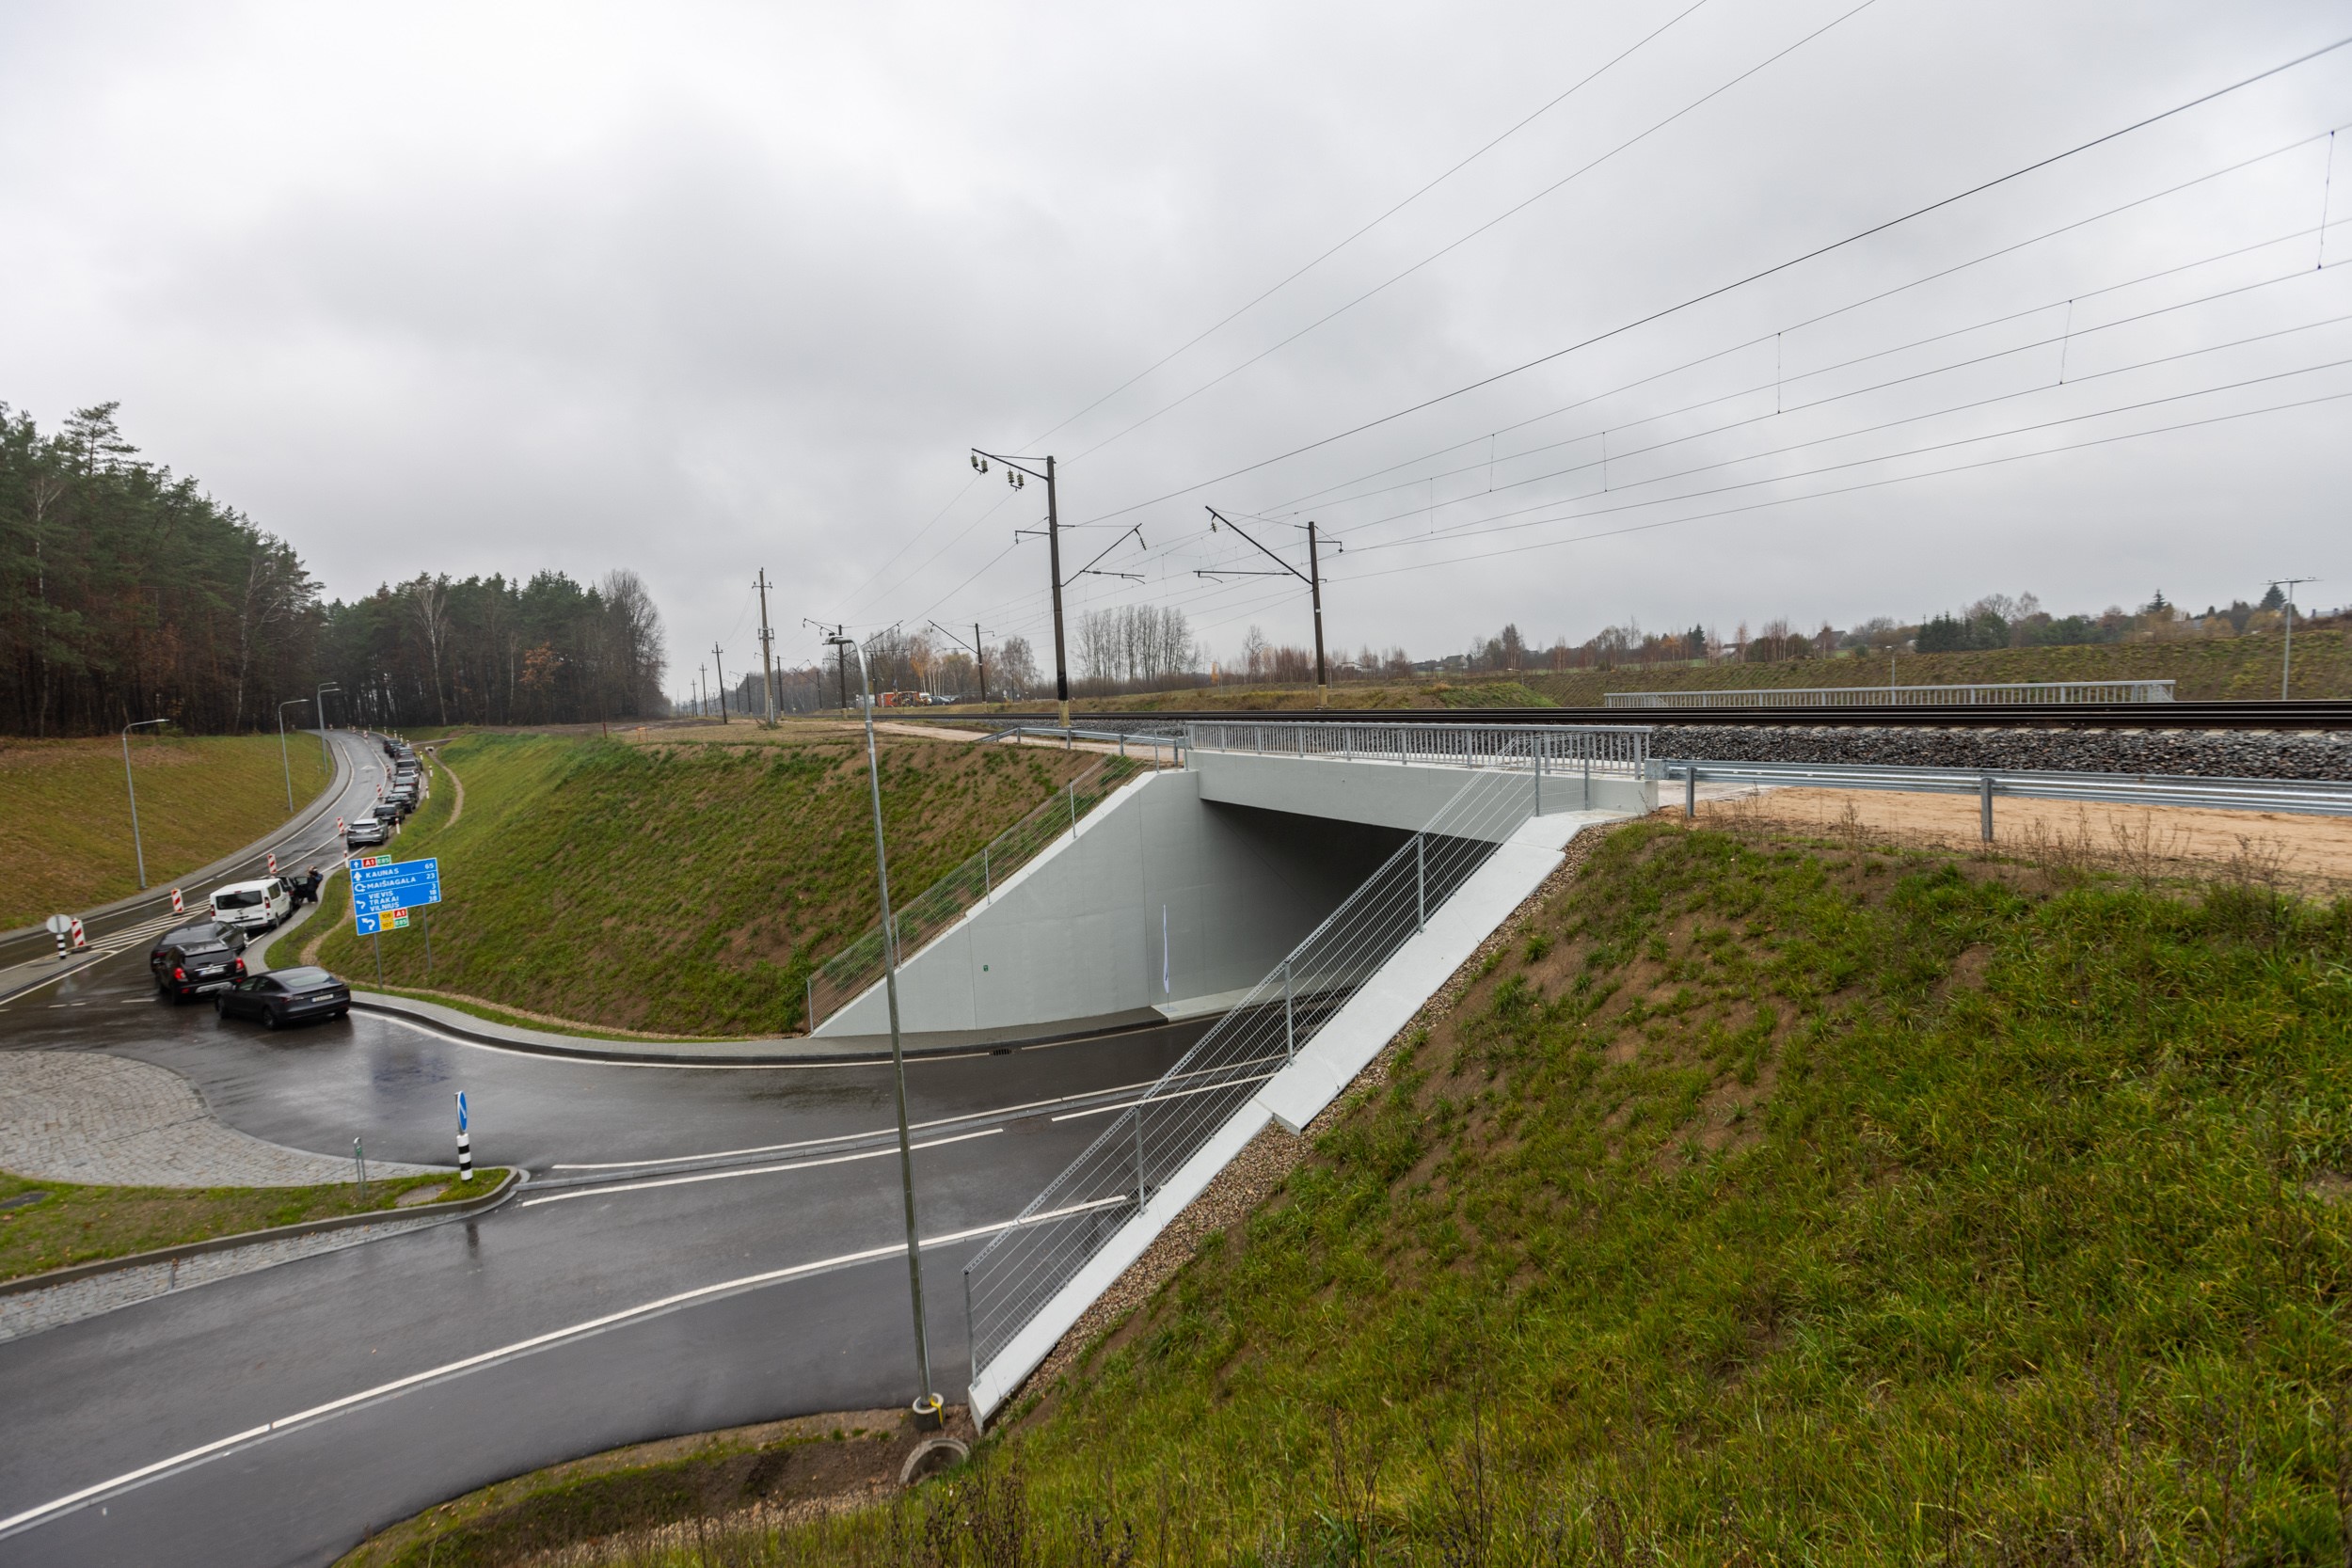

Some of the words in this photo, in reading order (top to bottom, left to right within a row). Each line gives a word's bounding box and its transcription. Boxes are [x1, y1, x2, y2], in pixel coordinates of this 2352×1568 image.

[366, 868, 399, 878] KAUNAS
[367, 877, 416, 889] MAIŠIAGALA
[368, 890, 393, 899] VIEVIS
[369, 896, 399, 905] TRAKAI
[370, 902, 399, 912] VILNIUS
